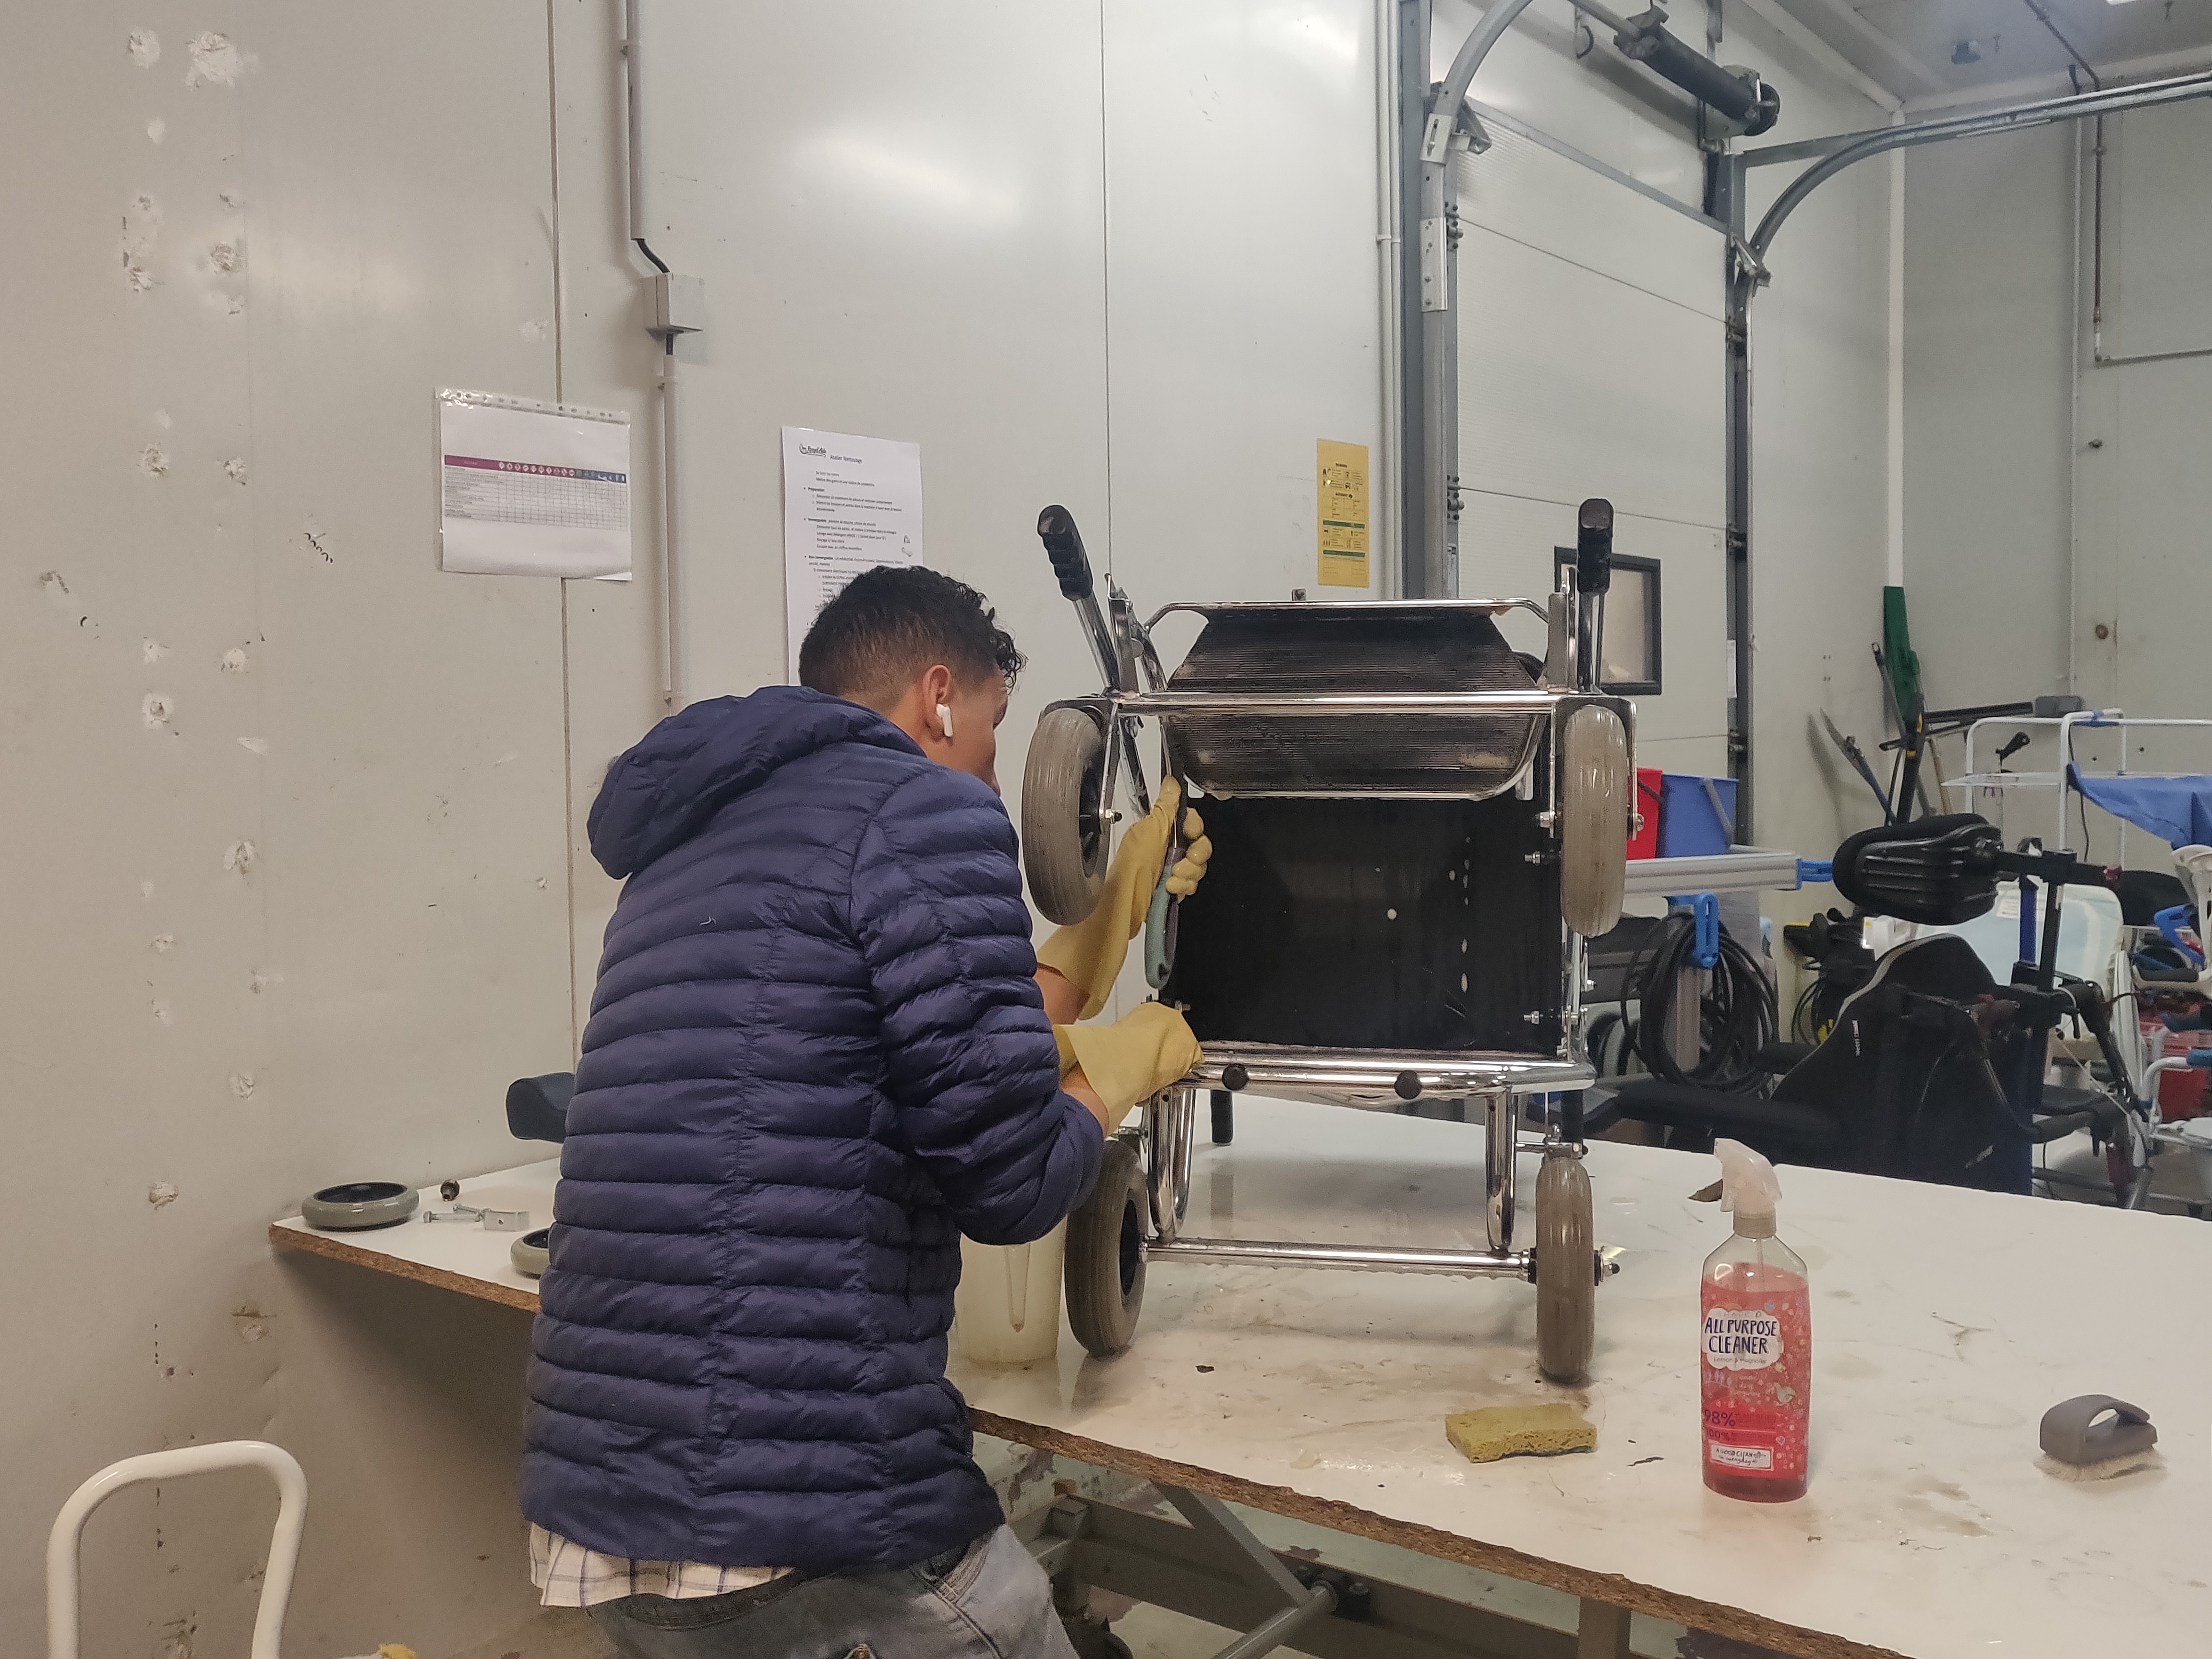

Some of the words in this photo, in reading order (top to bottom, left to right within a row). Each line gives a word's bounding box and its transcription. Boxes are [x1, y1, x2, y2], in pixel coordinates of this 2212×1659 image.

[1705, 1317, 1724, 1334] ALL
[1727, 1320, 1778, 1336] PURPOSE
[1708, 1335, 1768, 1355] CLEANER
[1704, 1409, 1736, 1427] 98%
[1706, 1428, 1731, 1441] 100%
